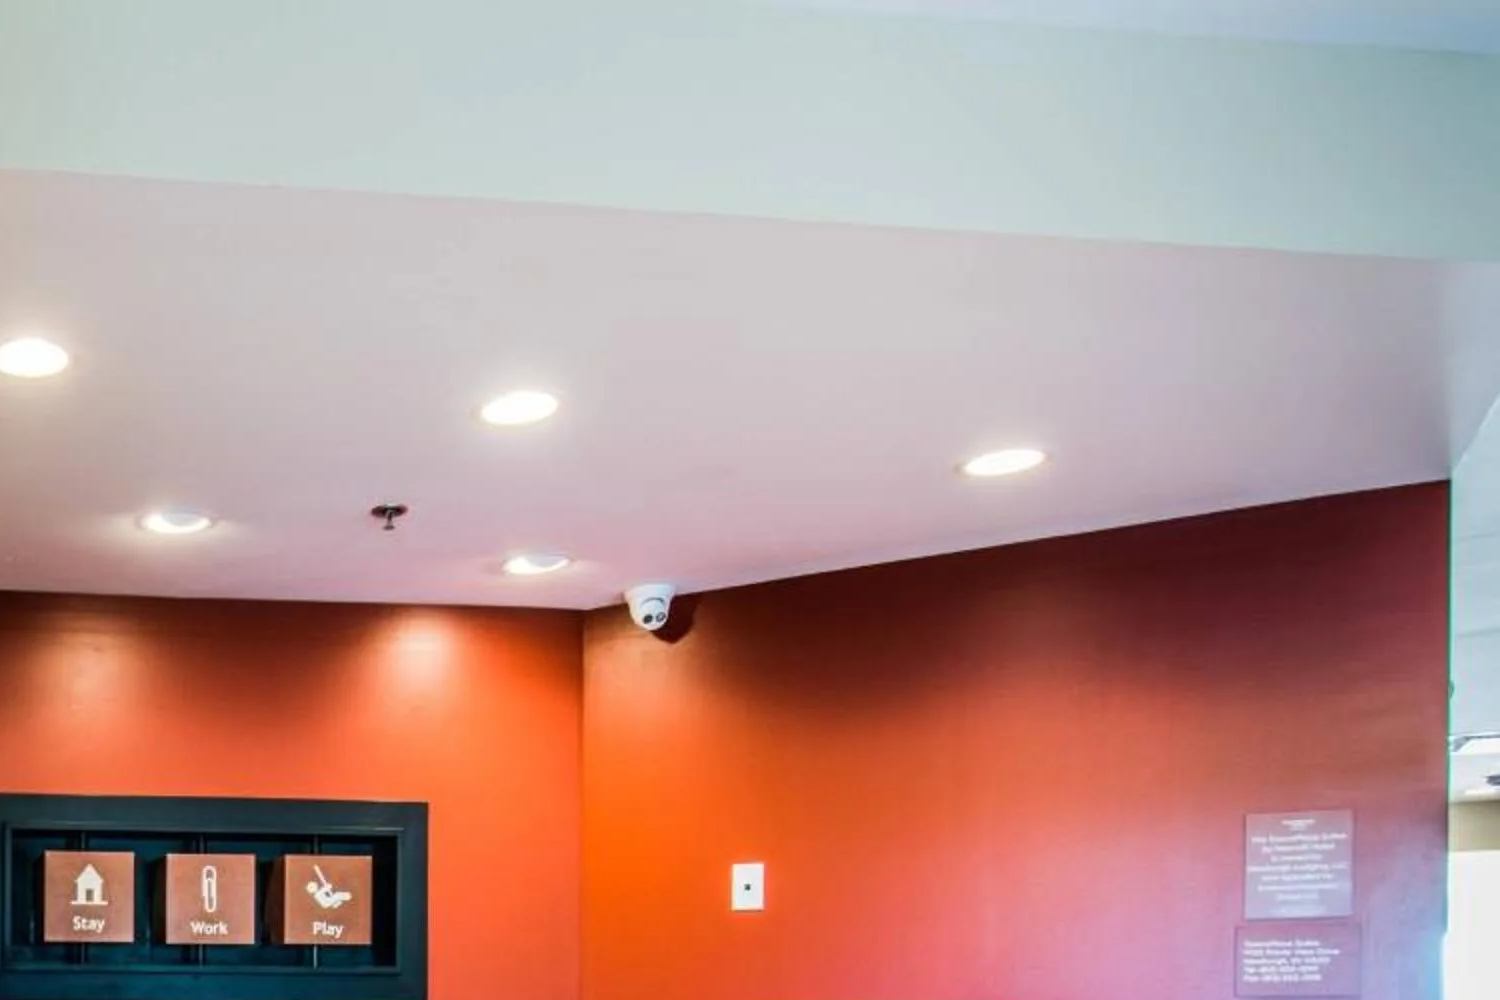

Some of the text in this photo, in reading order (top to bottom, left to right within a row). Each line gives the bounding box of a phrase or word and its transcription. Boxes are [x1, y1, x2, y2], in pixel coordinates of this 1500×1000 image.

[72, 915, 105, 933] Stay
[190, 920, 229, 936] Work
[313, 921, 345, 938] Play
